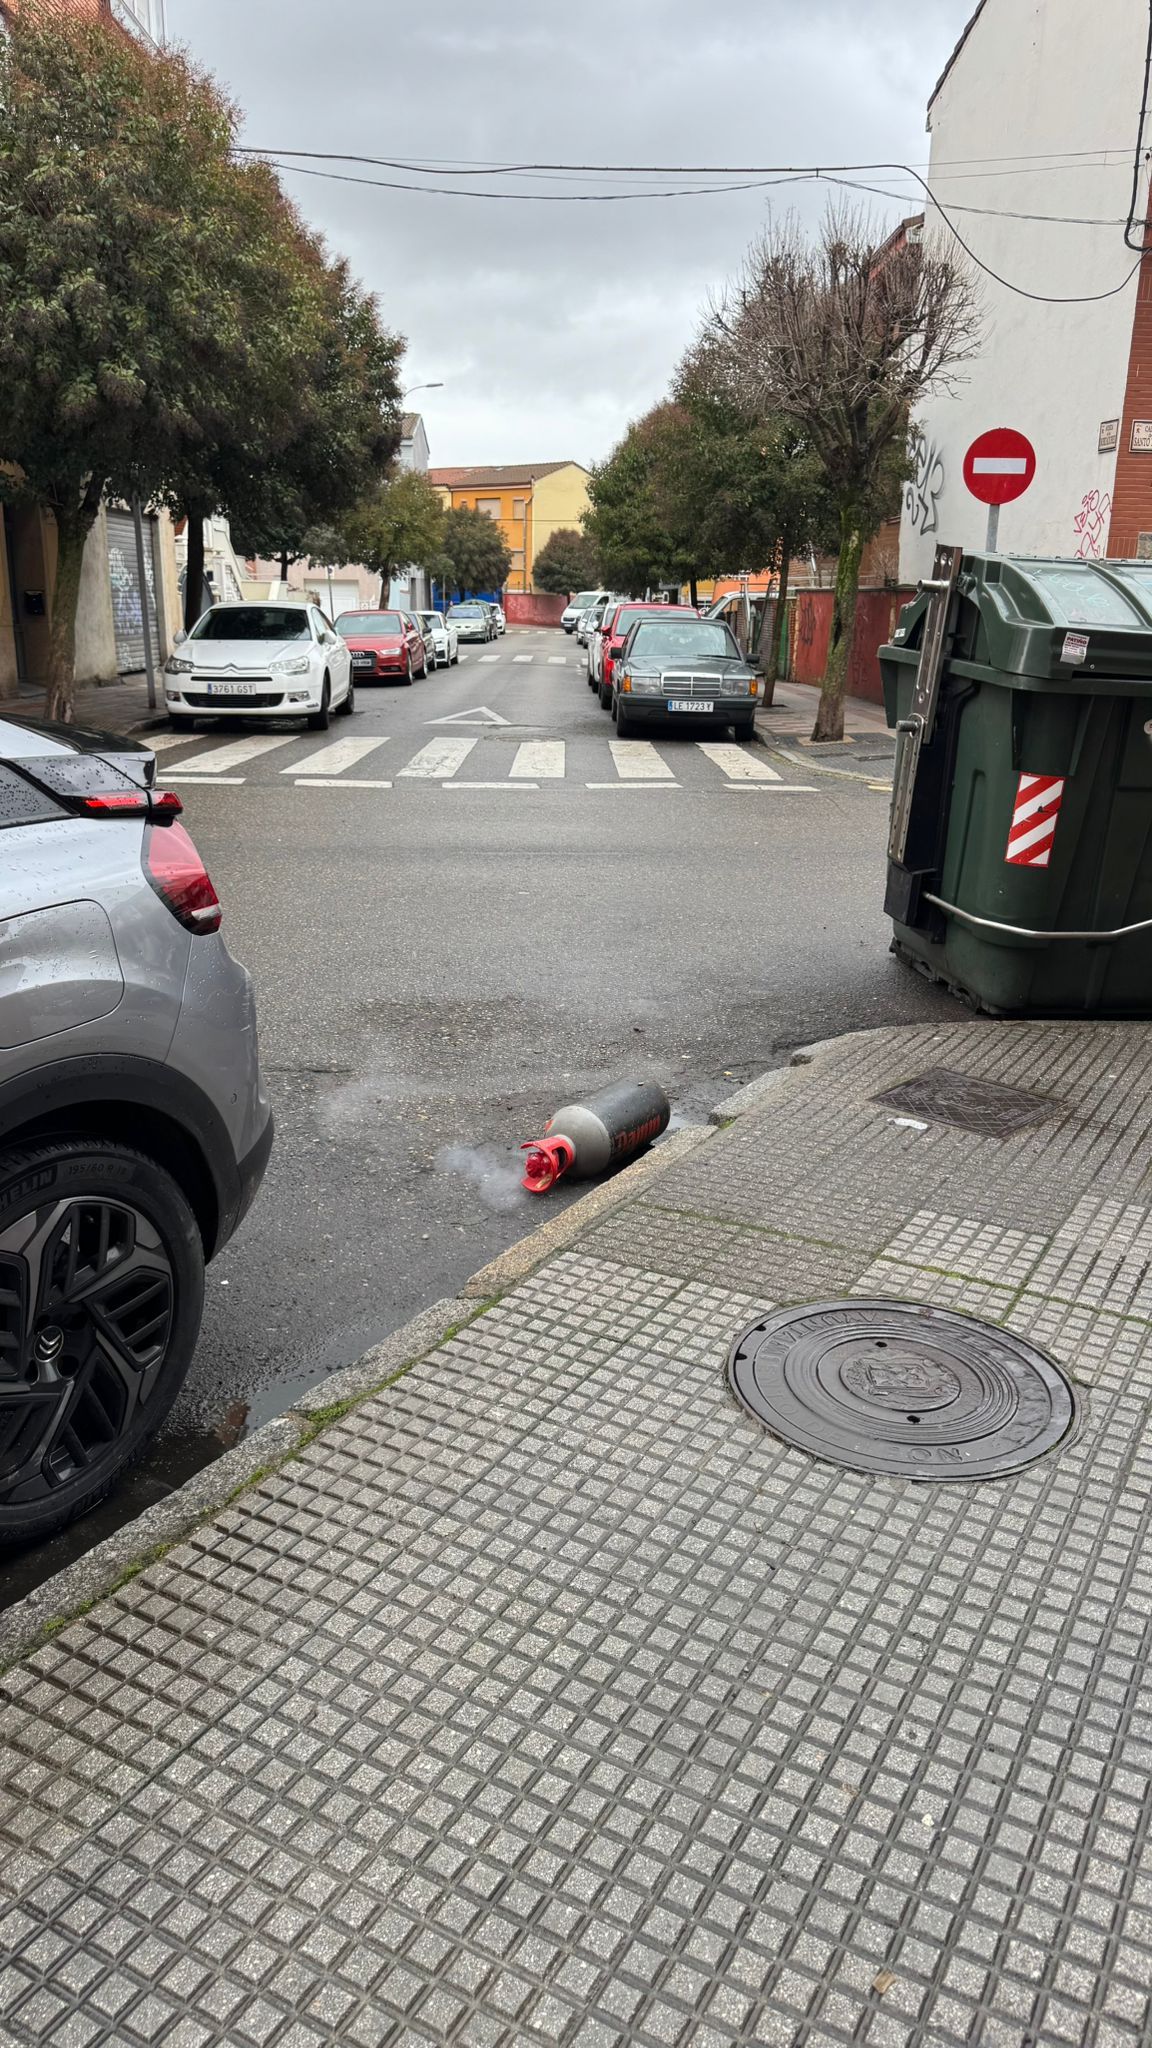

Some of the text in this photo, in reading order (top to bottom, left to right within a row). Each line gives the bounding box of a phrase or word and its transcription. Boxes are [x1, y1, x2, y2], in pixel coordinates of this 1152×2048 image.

[1133, 437, 1151, 447] SANTO
[213, 685, 254, 694] 3761 GST
[674, 702, 712, 711] LE 1723 Y
[615, 1115, 661, 1150] Damm
